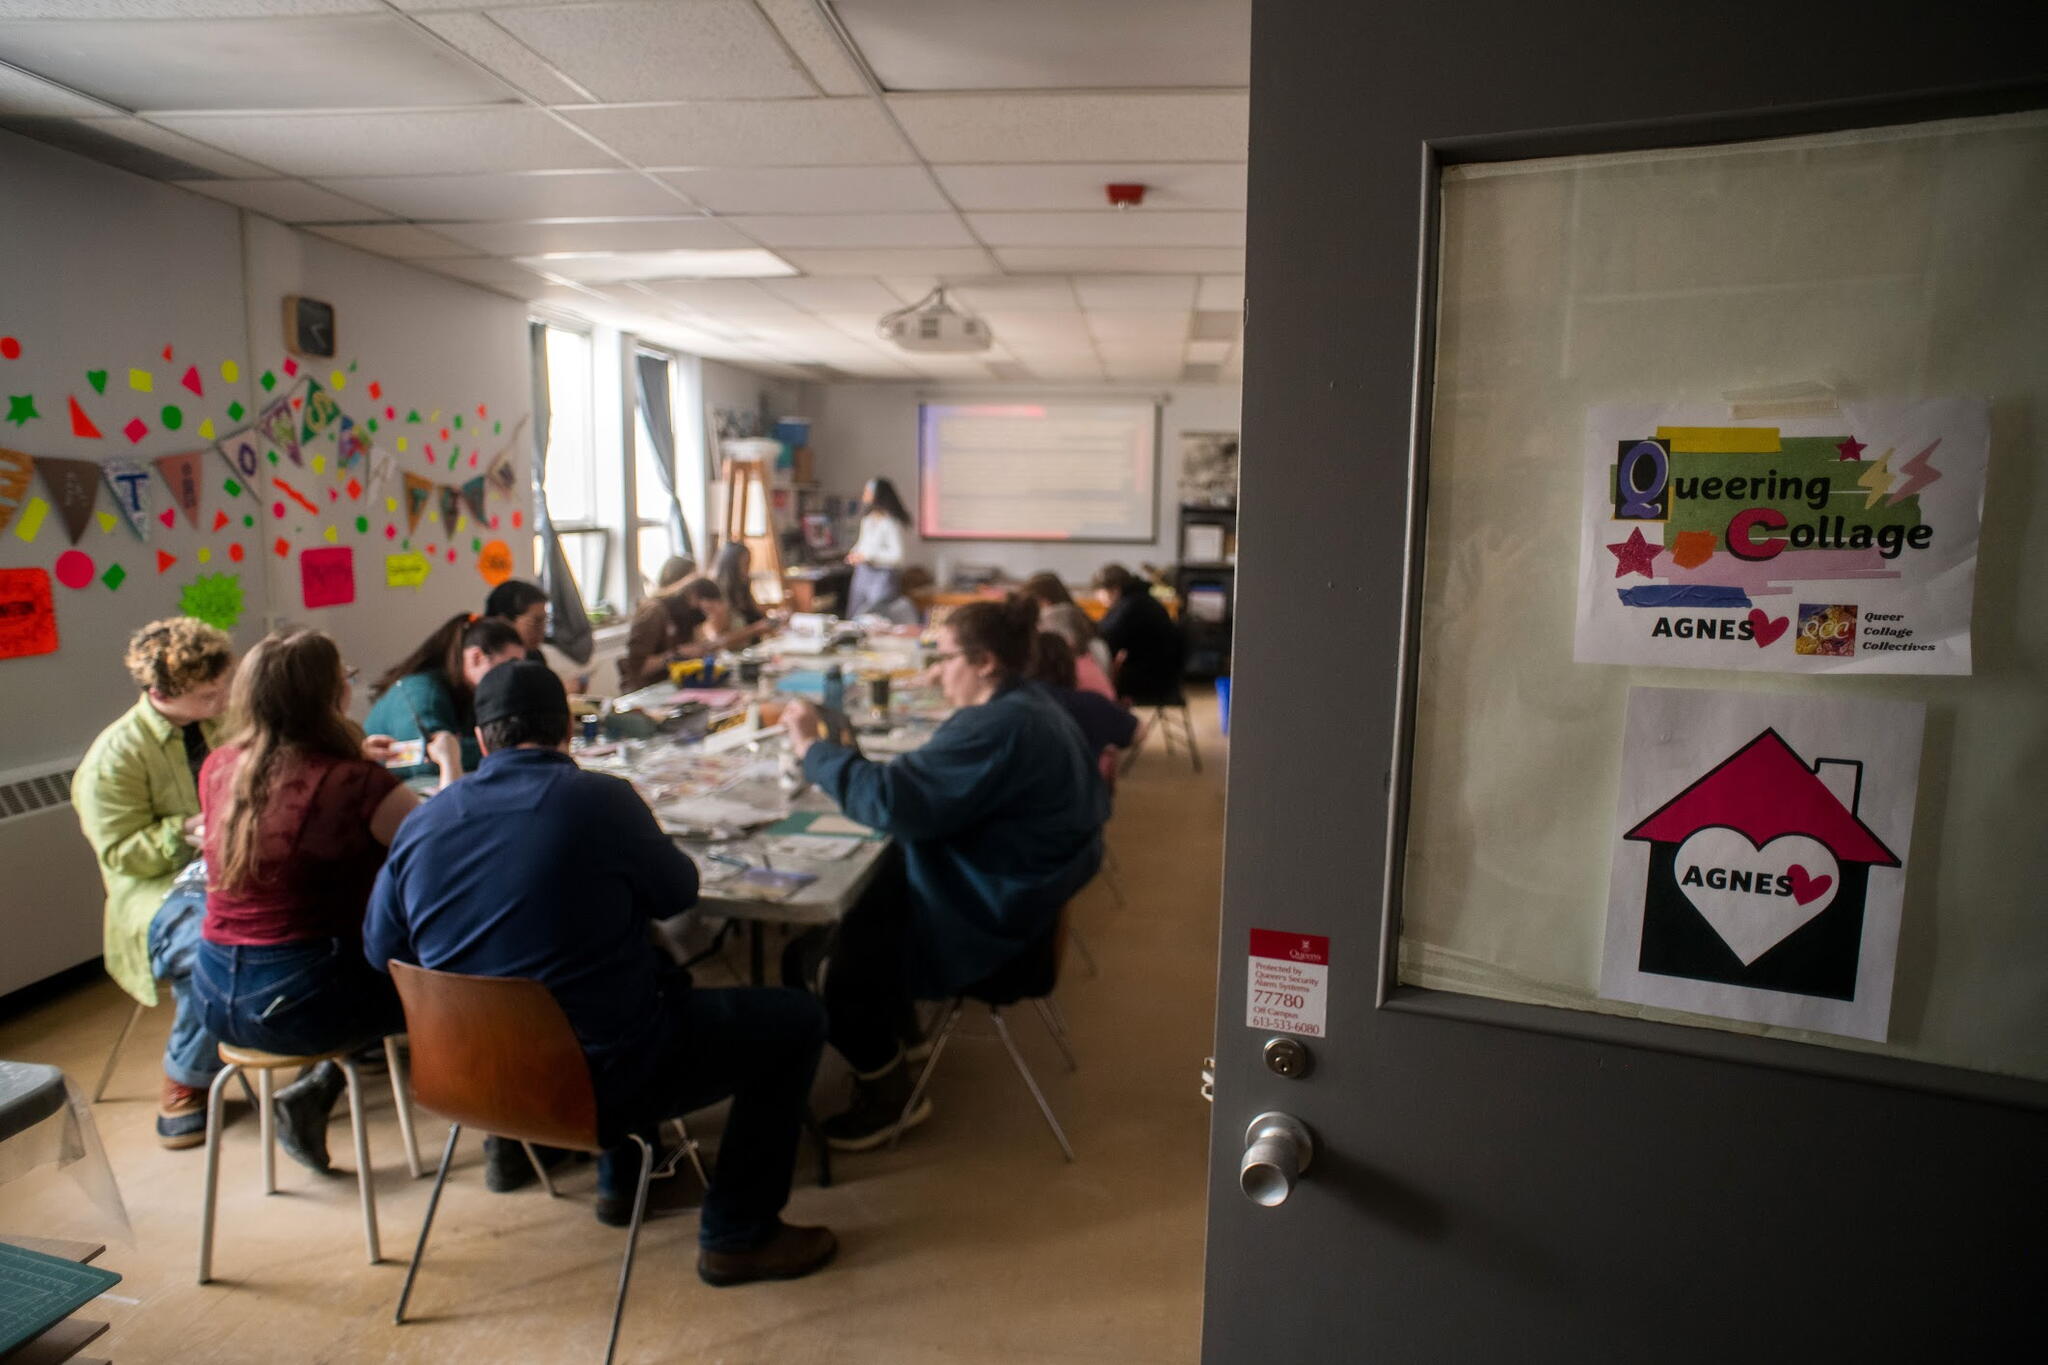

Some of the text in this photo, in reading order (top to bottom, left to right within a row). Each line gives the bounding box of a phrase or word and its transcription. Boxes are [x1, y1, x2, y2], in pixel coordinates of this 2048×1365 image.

[1620, 440, 1830, 518] Queering
[1726, 507, 1933, 562] Collage
[1864, 612, 1904, 623] Queer
[1651, 616, 1850, 641] AGNES QCC
[1863, 626, 1913, 639] Collage
[1862, 641, 1936, 652] Collectives
[1681, 865, 1794, 897] AGNES
[1255, 962, 1303, 976] Protected by
[1255, 979, 1310, 993] Alarm Systems
[1289, 975, 1319, 987] Security
[1253, 989, 1304, 1009] 77780
[1267, 1007, 1298, 1019] Campus
[1253, 1015, 1320, 1035] 613-533-6080
